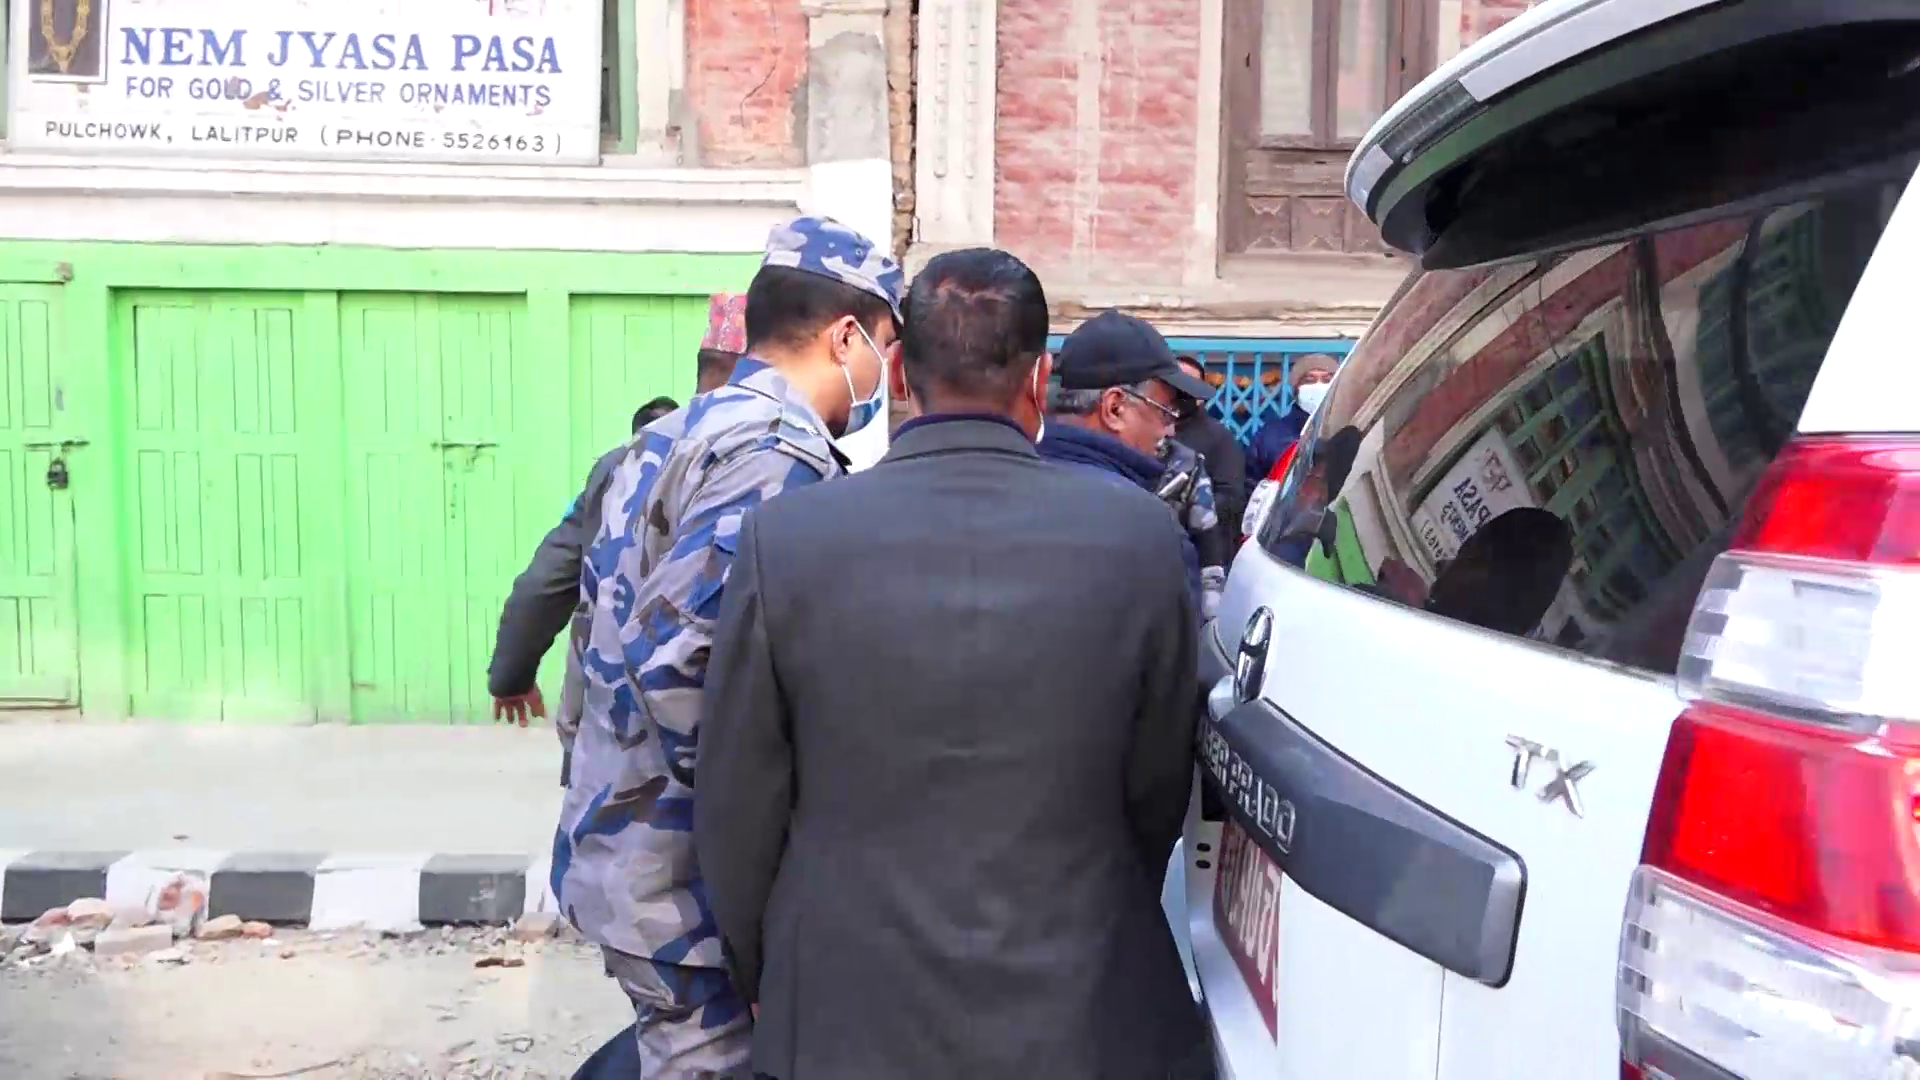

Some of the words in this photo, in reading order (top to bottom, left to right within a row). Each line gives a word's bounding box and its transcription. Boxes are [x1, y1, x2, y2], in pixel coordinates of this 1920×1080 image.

[120, 27, 247, 66] NEM
[267, 30, 428, 71] JYASA
[451, 34, 562, 73] PASA
[126, 76, 173, 99] FOR
[189, 77, 252, 100] GOLD
[268, 78, 284, 101] &
[298, 79, 385, 103] SILVER
[400, 83, 551, 107] ORNAMENTS
[46, 121, 173, 144] PULCHOWK,
[192, 126, 298, 143] LALITPUR
[1505, 733, 1596, 819] TX
[1228, 751, 1296, 855] PRADO
